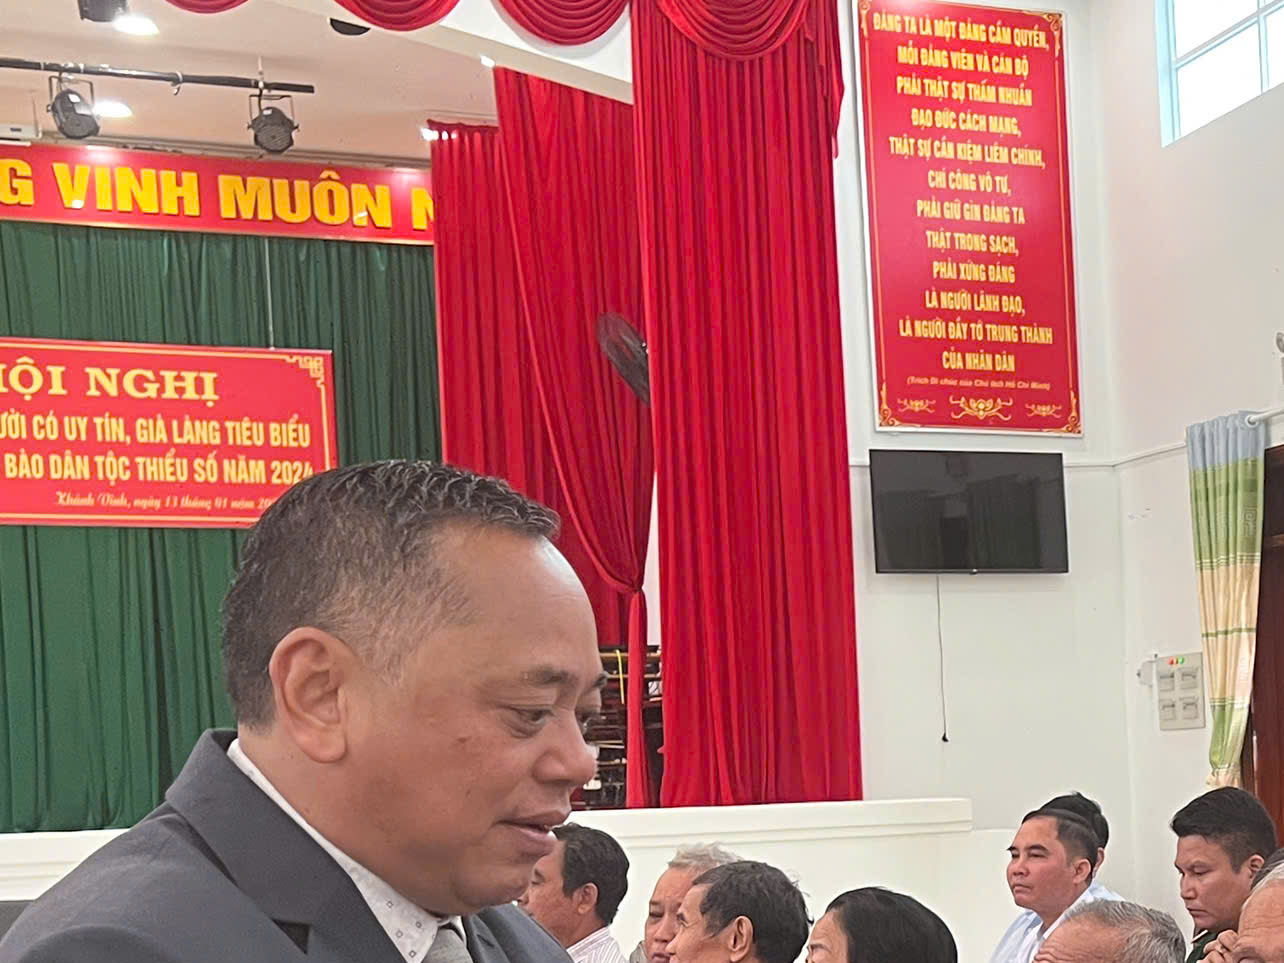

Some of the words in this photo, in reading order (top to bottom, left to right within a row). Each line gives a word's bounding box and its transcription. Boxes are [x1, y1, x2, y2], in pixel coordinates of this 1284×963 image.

[904, 16, 917, 34] TA
[920, 14, 932, 35] LÀ
[934, 16, 956, 41] MỘT
[959, 17, 987, 42] ĐẢNG
[920, 43, 949, 68] ĐẢNG
[950, 48, 975, 71] VIÊN
[976, 50, 991, 72] VÀ
[992, 52, 1013, 75] CÁN
[1014, 55, 1029, 80] BỘ
[897, 73, 922, 96] PHẢI
[923, 76, 949, 102] THẬT
[951, 81, 965, 104] SỰ
[912, 108, 933, 130] ĐẠO
[959, 109, 987, 132] CÁCH
[889, 133, 915, 159] THẬT
[917, 137, 931, 161] SỰ
[957, 139, 982, 165] KIỆM
[984, 142, 1009, 163] LIÊM
[928, 168, 947, 188] CHÍ
[948, 168, 976, 191] CÔNG
[978, 170, 992, 192] VÔ
[52, 162, 200, 217] VINH
[218, 170, 392, 229] MUÔN
[917, 195, 941, 218] PHẢI
[983, 199, 1010, 224] ĐẢNG
[1012, 207, 1025, 224] TA
[926, 227, 951, 253] THẬT
[953, 233, 987, 252] TRONG
[989, 235, 1019, 257] SẠCH,
[932, 257, 957, 279] PHẢI
[959, 259, 986, 281] XỨNG
[925, 286, 939, 308] LÀ
[940, 288, 972, 311] NGƯỜI
[899, 315, 913, 337] LÀ
[914, 316, 946, 339] NGƯỜI
[985, 323, 1018, 343] TRUNG
[1020, 322, 1053, 344] THÀNH
[942, 346, 964, 369] CỦA
[965, 349, 992, 371] NHÂN
[995, 350, 1015, 372] DÂN
[85, 366, 219, 407] NGHỊ
[33, 410, 59, 440] CÓ
[63, 415, 88, 441] UY
[93, 411, 131, 445] TÍN,
[136, 413, 168, 443] GIÀ
[172, 414, 220, 445] LÀNG
[224, 416, 264, 447] TIÊU
[269, 413, 311, 448] BIỂU
[4, 448, 44, 479] BÀO
[49, 449, 90, 480] DÂN
[94, 450, 131, 487] TỘC
[135, 448, 188, 482] THIỂU
[193, 450, 218, 483] SỐ
[223, 455, 266, 484] NĂM
